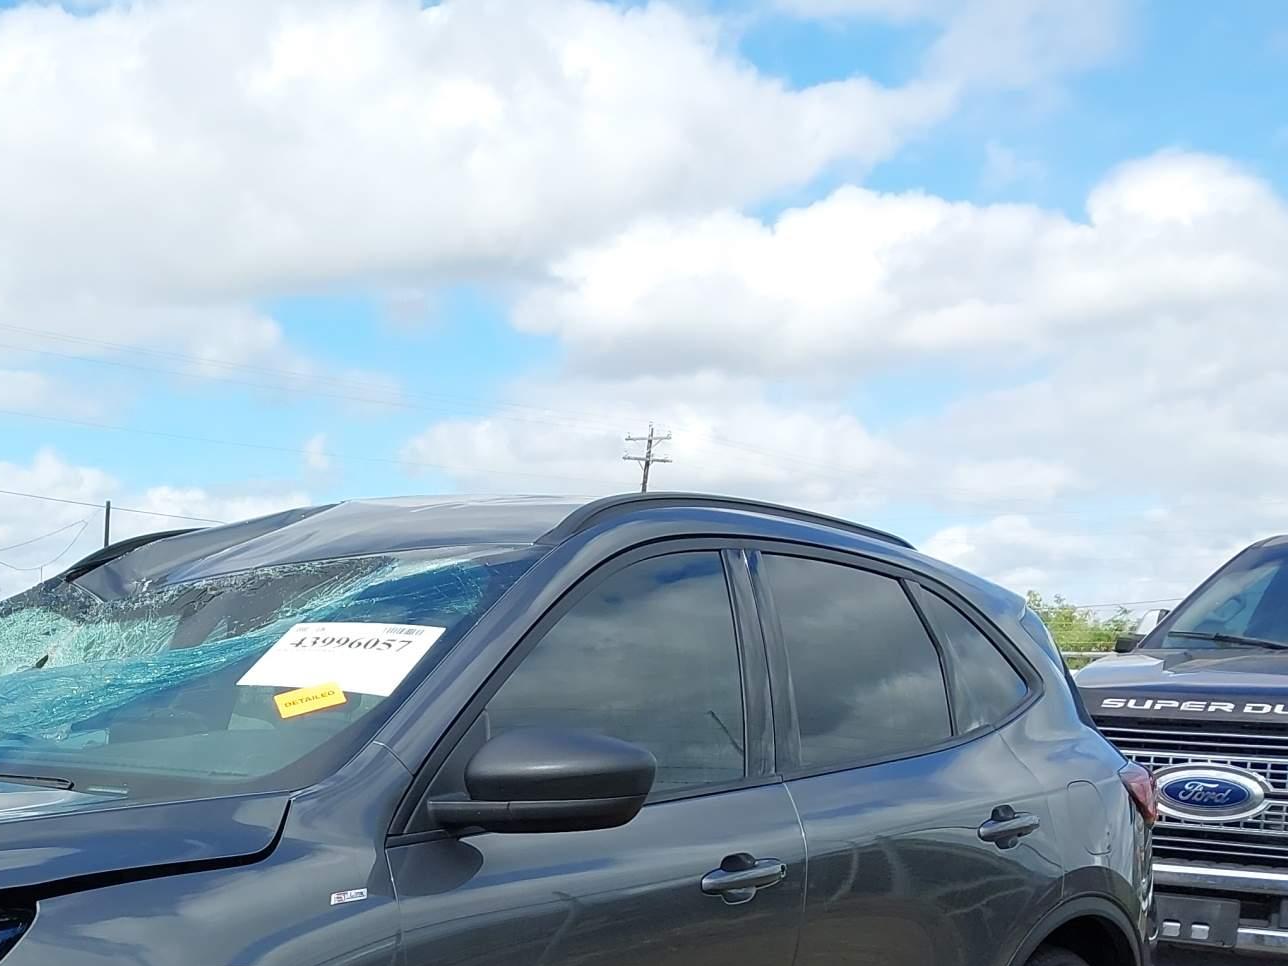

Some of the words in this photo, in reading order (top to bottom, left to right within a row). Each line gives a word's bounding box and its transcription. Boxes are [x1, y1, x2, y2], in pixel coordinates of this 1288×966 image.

[290, 636, 413, 652] 43996057
[284, 690, 336, 708] DETAILED
[1100, 698, 1235, 713] SUPER
[1177, 780, 1233, 804] Ford
